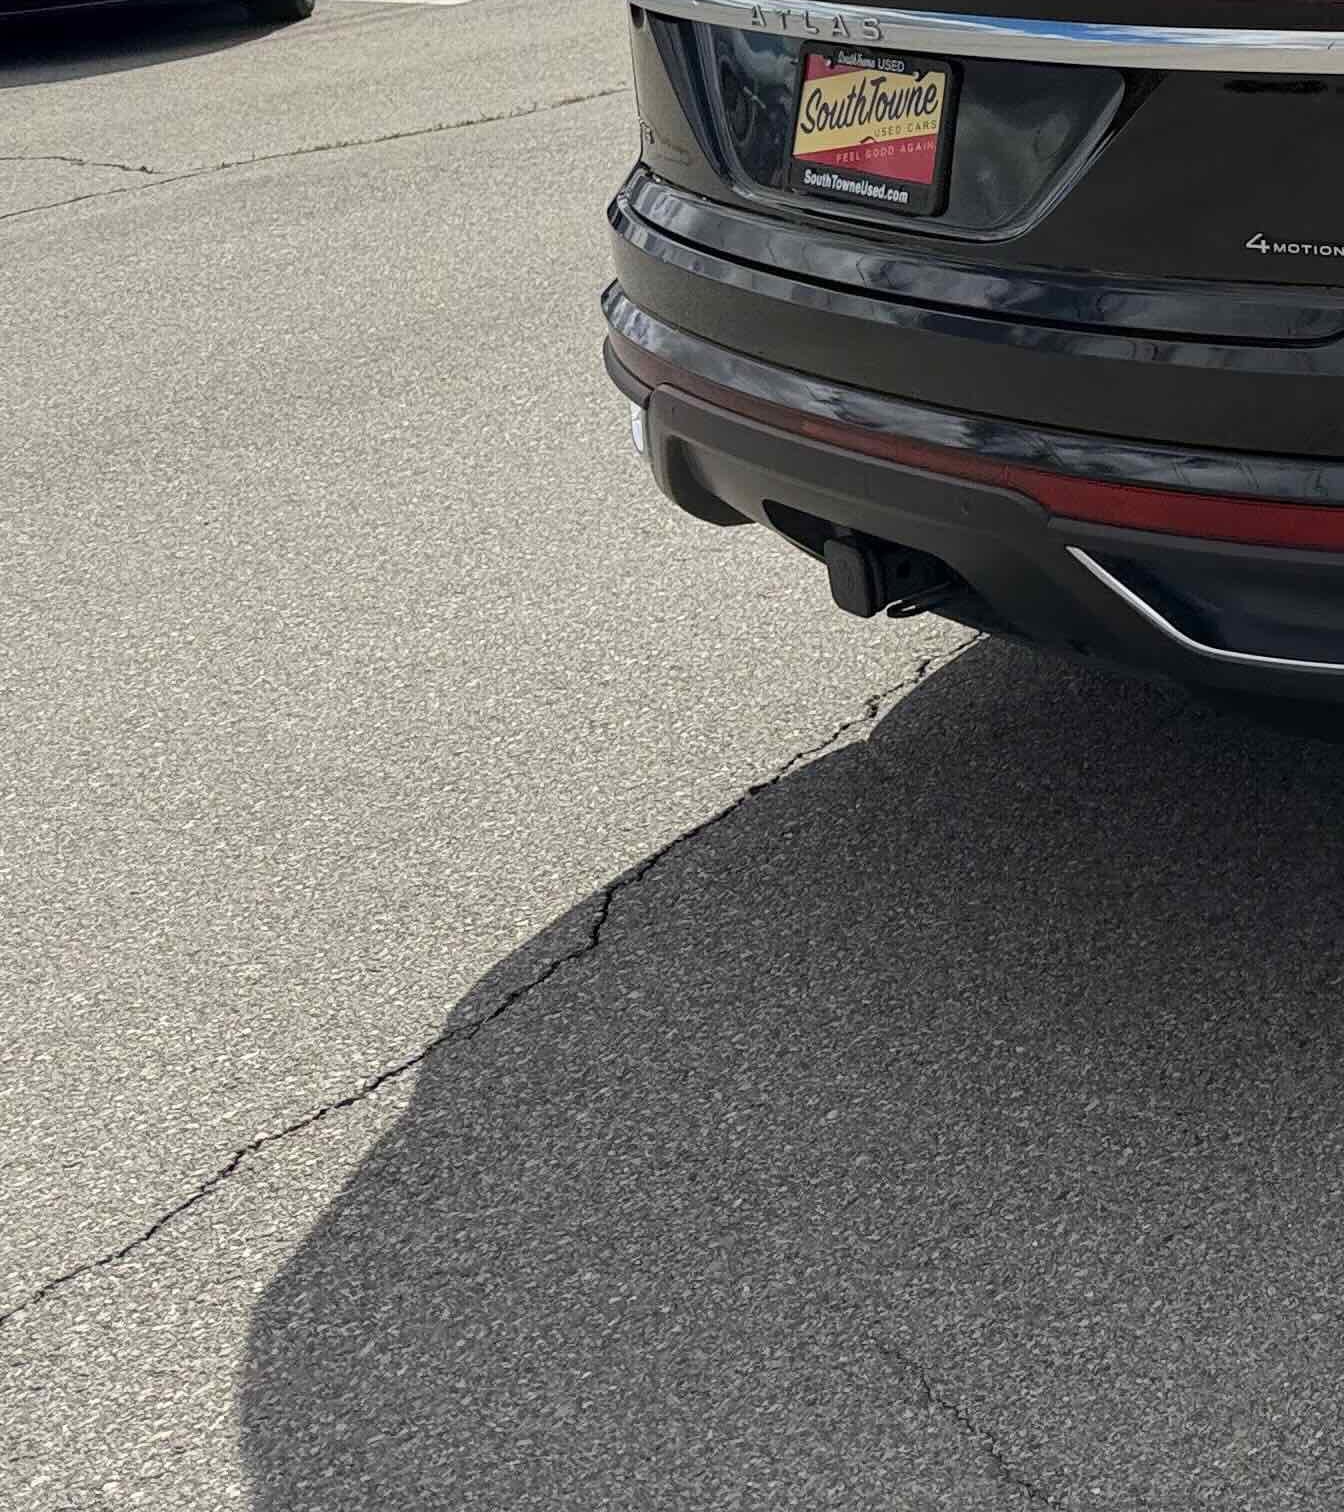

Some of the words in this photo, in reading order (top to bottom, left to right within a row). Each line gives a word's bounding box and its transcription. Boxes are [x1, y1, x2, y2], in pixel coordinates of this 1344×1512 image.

[751, 4, 883, 40] ATLAS
[877, 57, 905, 73] USED
[800, 75, 939, 134] SouthTowne
[874, 125, 902, 138] USED
[908, 120, 937, 133] CARS
[836, 153, 861, 163] FEEL
[865, 146, 895, 160] GOOD
[804, 168, 909, 204] SouthTowneUsed.com
